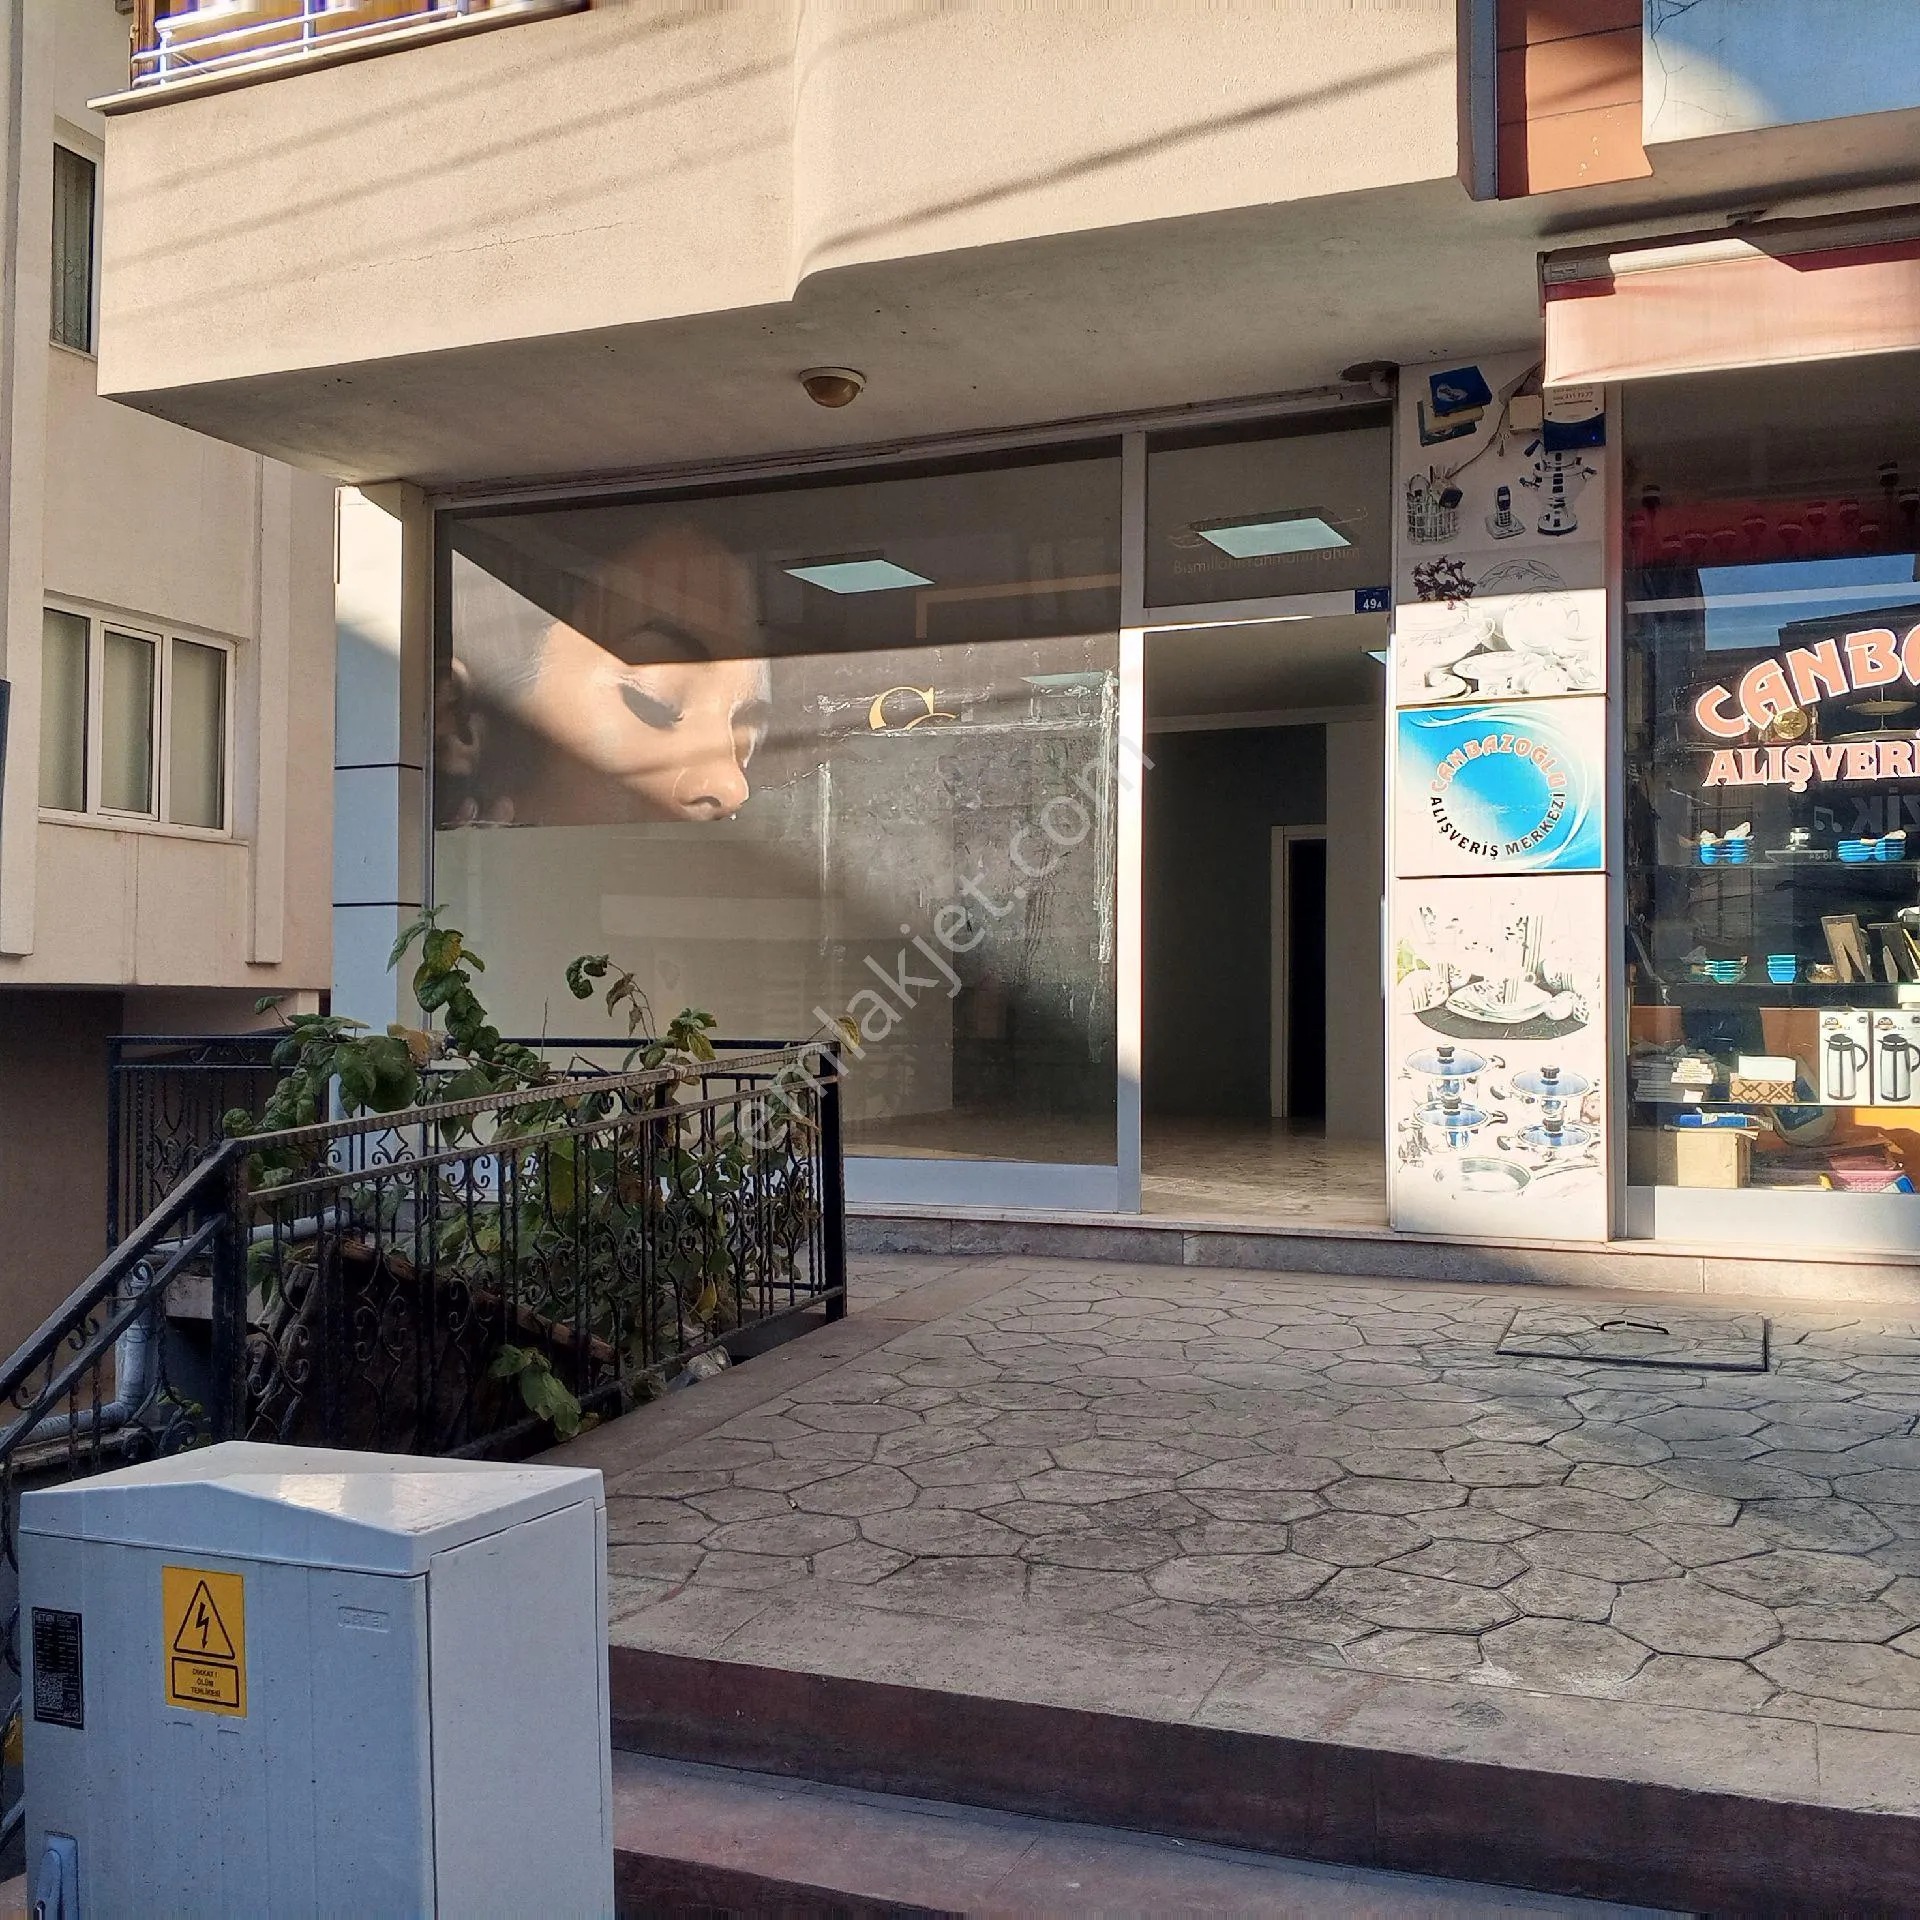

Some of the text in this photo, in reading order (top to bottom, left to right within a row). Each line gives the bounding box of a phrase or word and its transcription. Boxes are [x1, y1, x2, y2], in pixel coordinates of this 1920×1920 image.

[1431, 734, 1567, 793] CANBAZOĞLU
[1430, 793, 1566, 860] ALIŞVERİŞ MERKEZİ
